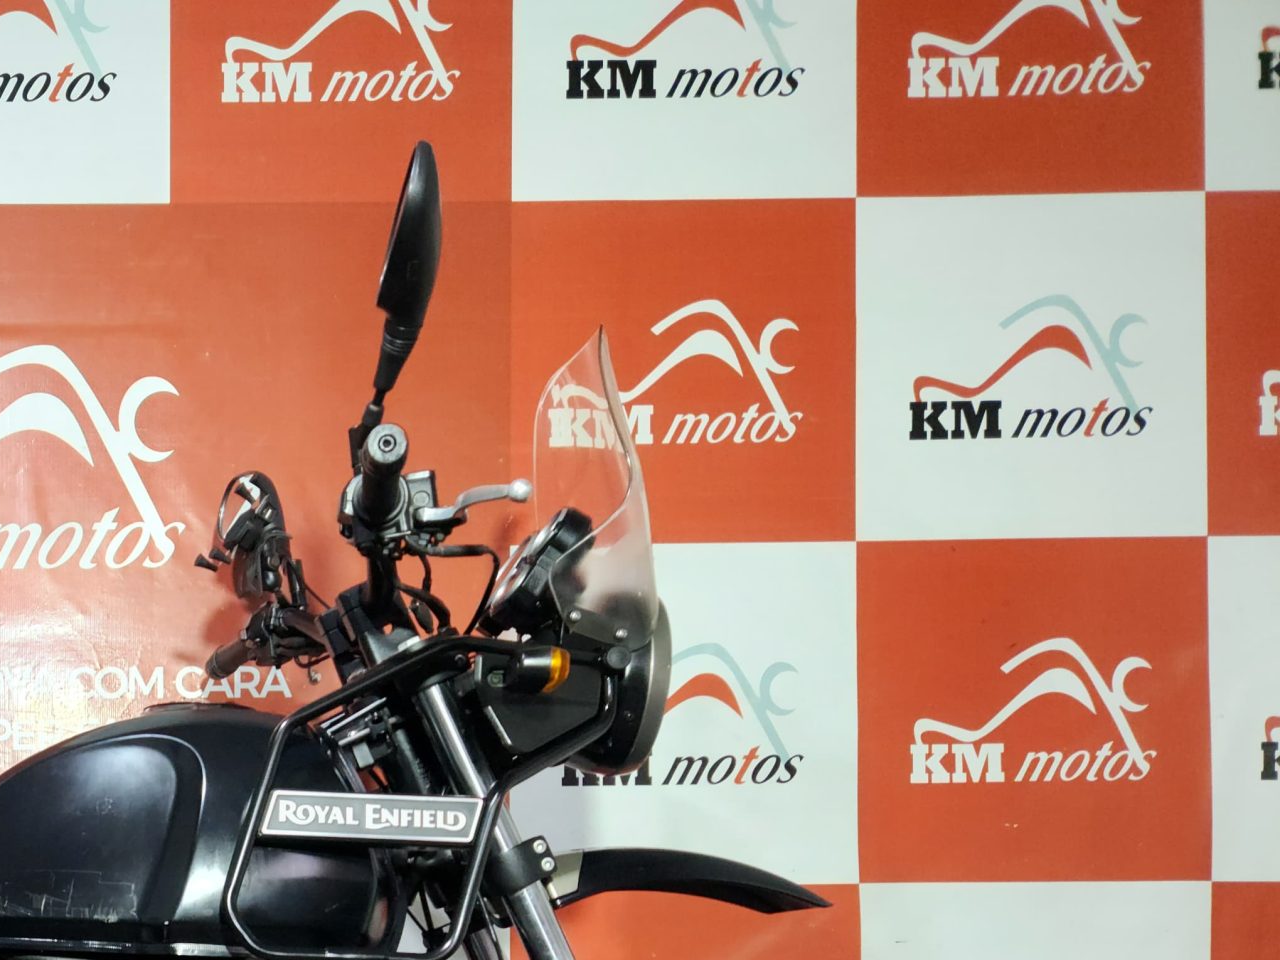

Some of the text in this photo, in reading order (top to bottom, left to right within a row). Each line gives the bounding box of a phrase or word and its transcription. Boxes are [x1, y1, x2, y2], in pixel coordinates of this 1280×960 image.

[221, 62, 461, 103] KM motos
[565, 59, 805, 99] KM motos
[908, 54, 1151, 98] KM motos
[661, 402, 804, 444] motos
[909, 400, 1153, 440] KM motos
[69, 666, 164, 699] COM
[176, 666, 293, 699] CARA
[661, 744, 805, 785] motos
[910, 741, 1158, 784] KM motos
[278, 799, 467, 832] ROYAL ENFIELD
